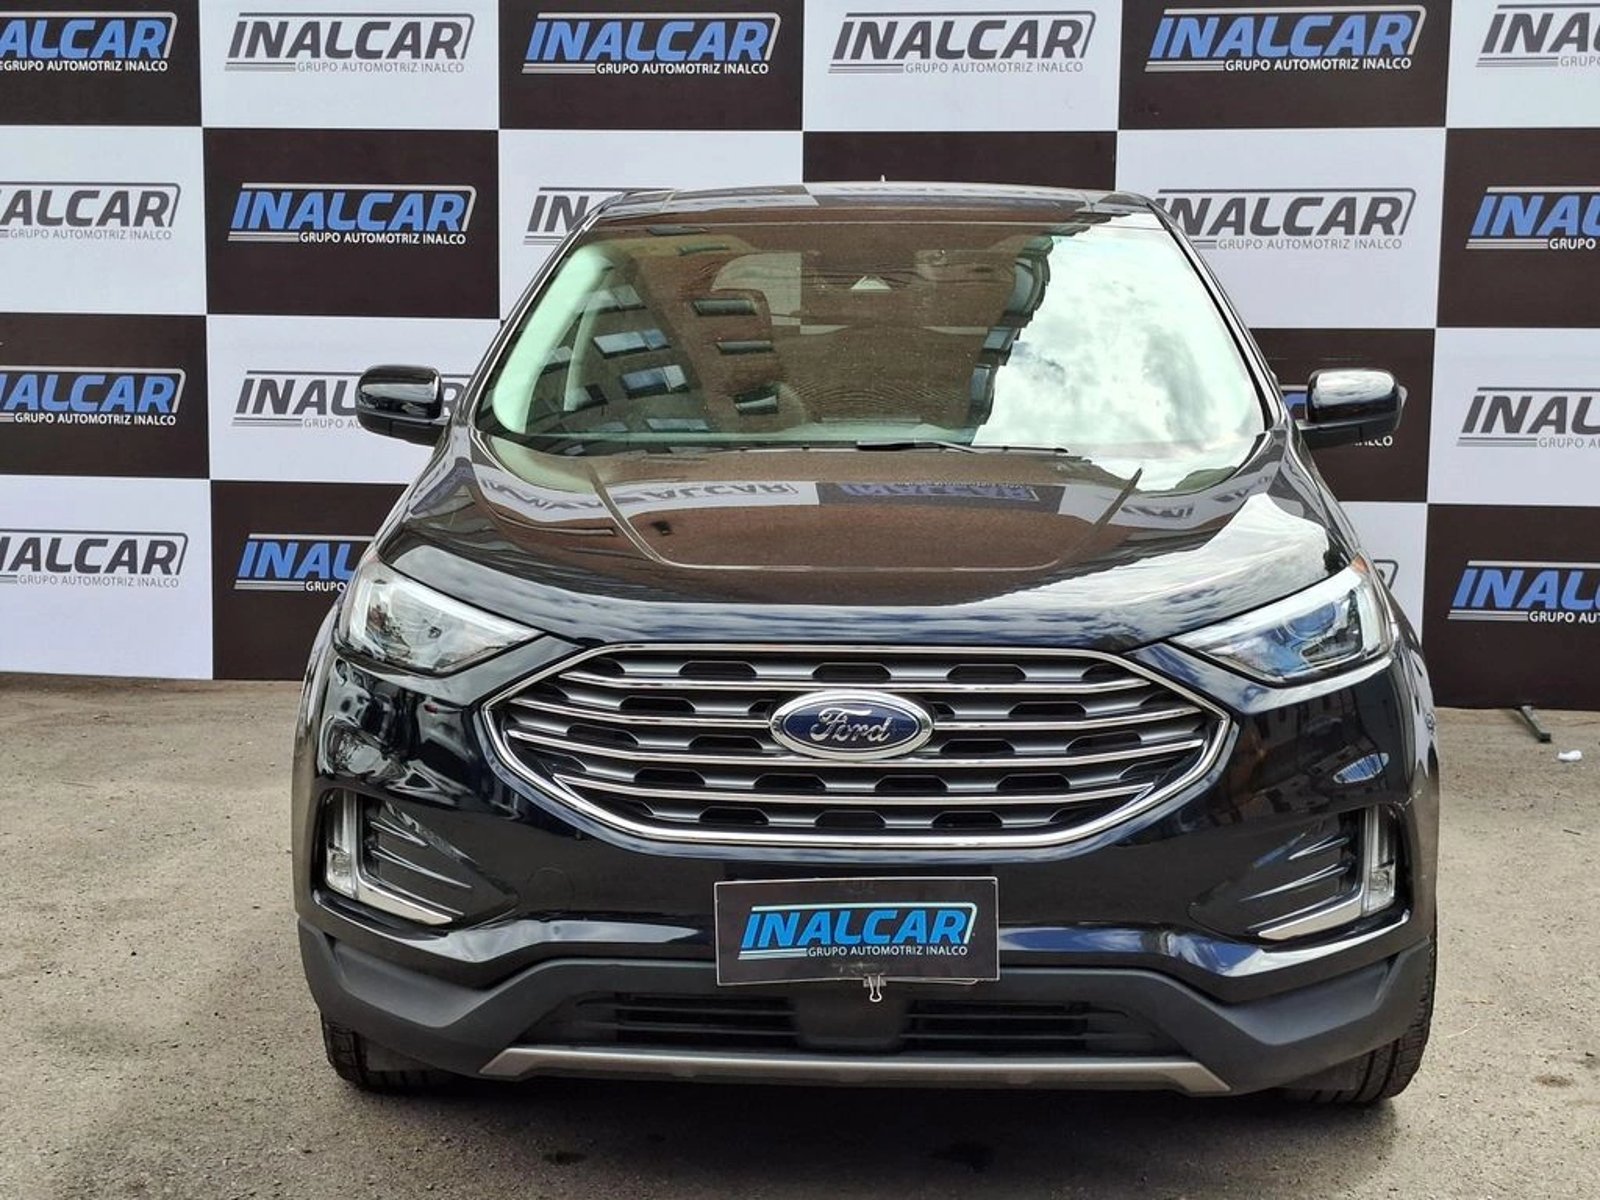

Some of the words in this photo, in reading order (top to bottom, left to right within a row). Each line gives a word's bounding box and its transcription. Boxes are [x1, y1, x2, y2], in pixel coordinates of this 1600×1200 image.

[1149, 14, 1413, 58] INALCAR
[1481, 12, 1600, 53] INA
[228, 21, 463, 60] INALCAR
[525, 21, 769, 61] INALCAR
[832, 20, 1084, 60] INALCAR
[4, 60, 44, 72] GRUPO
[47, 60, 122, 72] AUTOMOTRIZ
[125, 60, 168, 72] INALCO
[297, 62, 338, 73] GRUPO
[342, 62, 418, 73] AUTOMOTRIZ
[421, 62, 465, 73] INALCO
[596, 63, 638, 74] GRUPO
[641, 63, 720, 74] AUTOMOTRIZ
[724, 63, 769, 74] INALCO
[905, 62, 949, 74] GRUPO
[952, 62, 1032, 73] AUTOMOTRIZ
[1036, 62, 1083, 73] INALCO
[1225, 59, 1270, 72] GRUPO
[1274, 58, 1358, 71] AUTOMOTRIZ
[1362, 57, 1411, 70] INALCO
[0, 190, 170, 227] ALCAR
[231, 191, 465, 231] INALCAR
[10, 229, 49, 239] GRUPO
[52, 229, 126, 240] AUTOMOTRIZ
[130, 230, 172, 240] INALCO
[300, 231, 341, 243] GRUPO
[343, 232, 420, 244] AUTOMOTRIZ
[423, 233, 467, 245] INALCO
[1218, 238, 1262, 250] GRUPO
[1265, 238, 1350, 250] AUTOMOTRIZ
[1354, 238, 1402, 249] INALCO
[1549, 238, 1597, 250] GRUPO
[0, 373, 176, 413] ALCAR
[15, 412, 54, 424] GRUPO
[57, 413, 132, 425] AUTOMOTRIZ
[134, 414, 177, 426] INALCO
[304, 418, 343, 429] GRUPO
[1538, 437, 1584, 449] GRUPO
[19, 574, 59, 586] GRUPO
[61, 575, 134, 587] AUTOMOTRIZ
[137, 577, 179, 589] INALCO
[305, 580, 347, 592] GRUPO
[1452, 569, 1600, 610] INAL
[1529, 610, 1575, 623] GRUPO
[810, 707, 893, 742] Ford
[742, 910, 967, 948] INALCAR
[808, 946, 848, 957] GRUPO
[851, 945, 923, 956] AUTOMOTRIZ
[926, 945, 968, 956] INALCO
